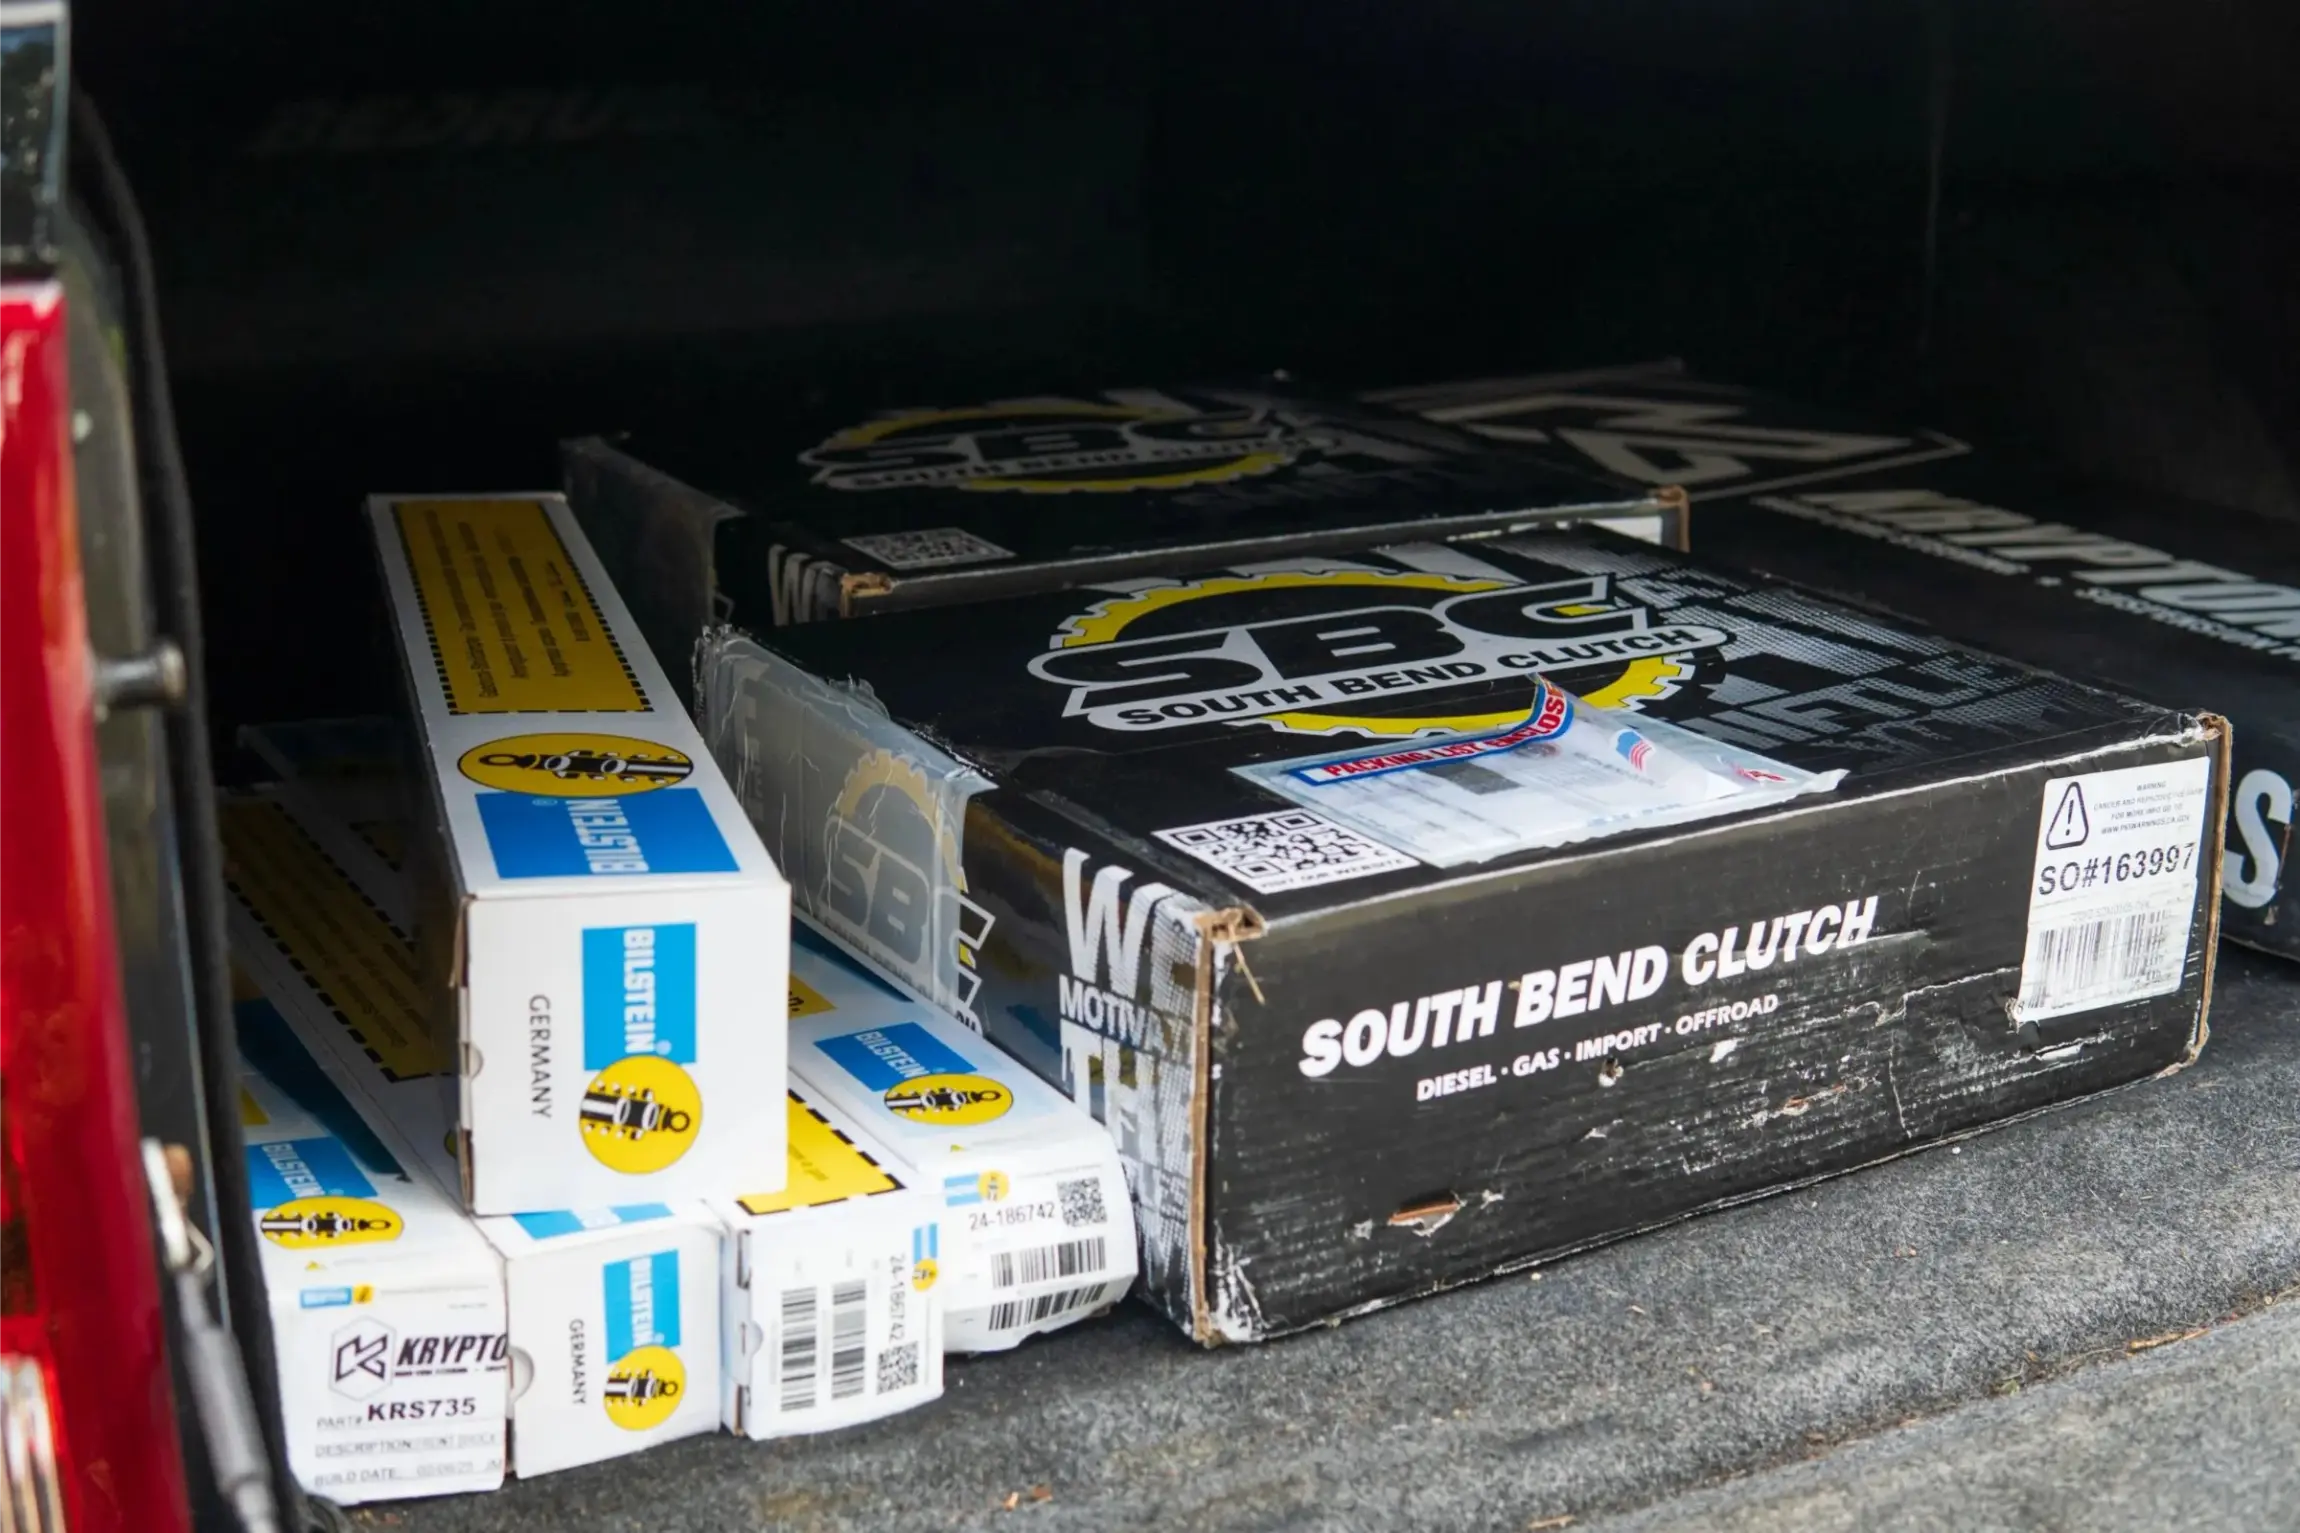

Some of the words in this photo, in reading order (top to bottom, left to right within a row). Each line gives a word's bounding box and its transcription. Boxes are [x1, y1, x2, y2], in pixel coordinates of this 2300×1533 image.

[1027, 574, 1651, 718] SBC
[1116, 684, 1324, 725] SOUTH
[1328, 661, 1487, 695] BEND
[1497, 628, 1702, 669] CLUTCH
[1322, 748, 1431, 776] PACKING
[1431, 741, 1482, 761] LIST
[564, 799, 650, 873] BILSTEIN
[2038, 842, 2196, 896] SO#163997
[624, 928, 656, 1054] BILSTEIN
[1299, 981, 1502, 1079] SOUTH
[1514, 944, 1669, 1029] BEND
[1681, 896, 1879, 987] CLUTCH
[529, 994, 552, 1118] GERMANY
[853, 1030, 931, 1078] BILSTEIN
[1416, 1066, 1497, 1101] DIESEL
[1513, 1048, 1559, 1078] GAS
[1575, 1021, 1663, 1063] IMPORT
[1675, 993, 1780, 1036] OFFROAD
[968, 1201, 1056, 1231] 24-186742
[569, 1318, 587, 1405] GERMANY
[367, 1396, 477, 1422] KRS735
